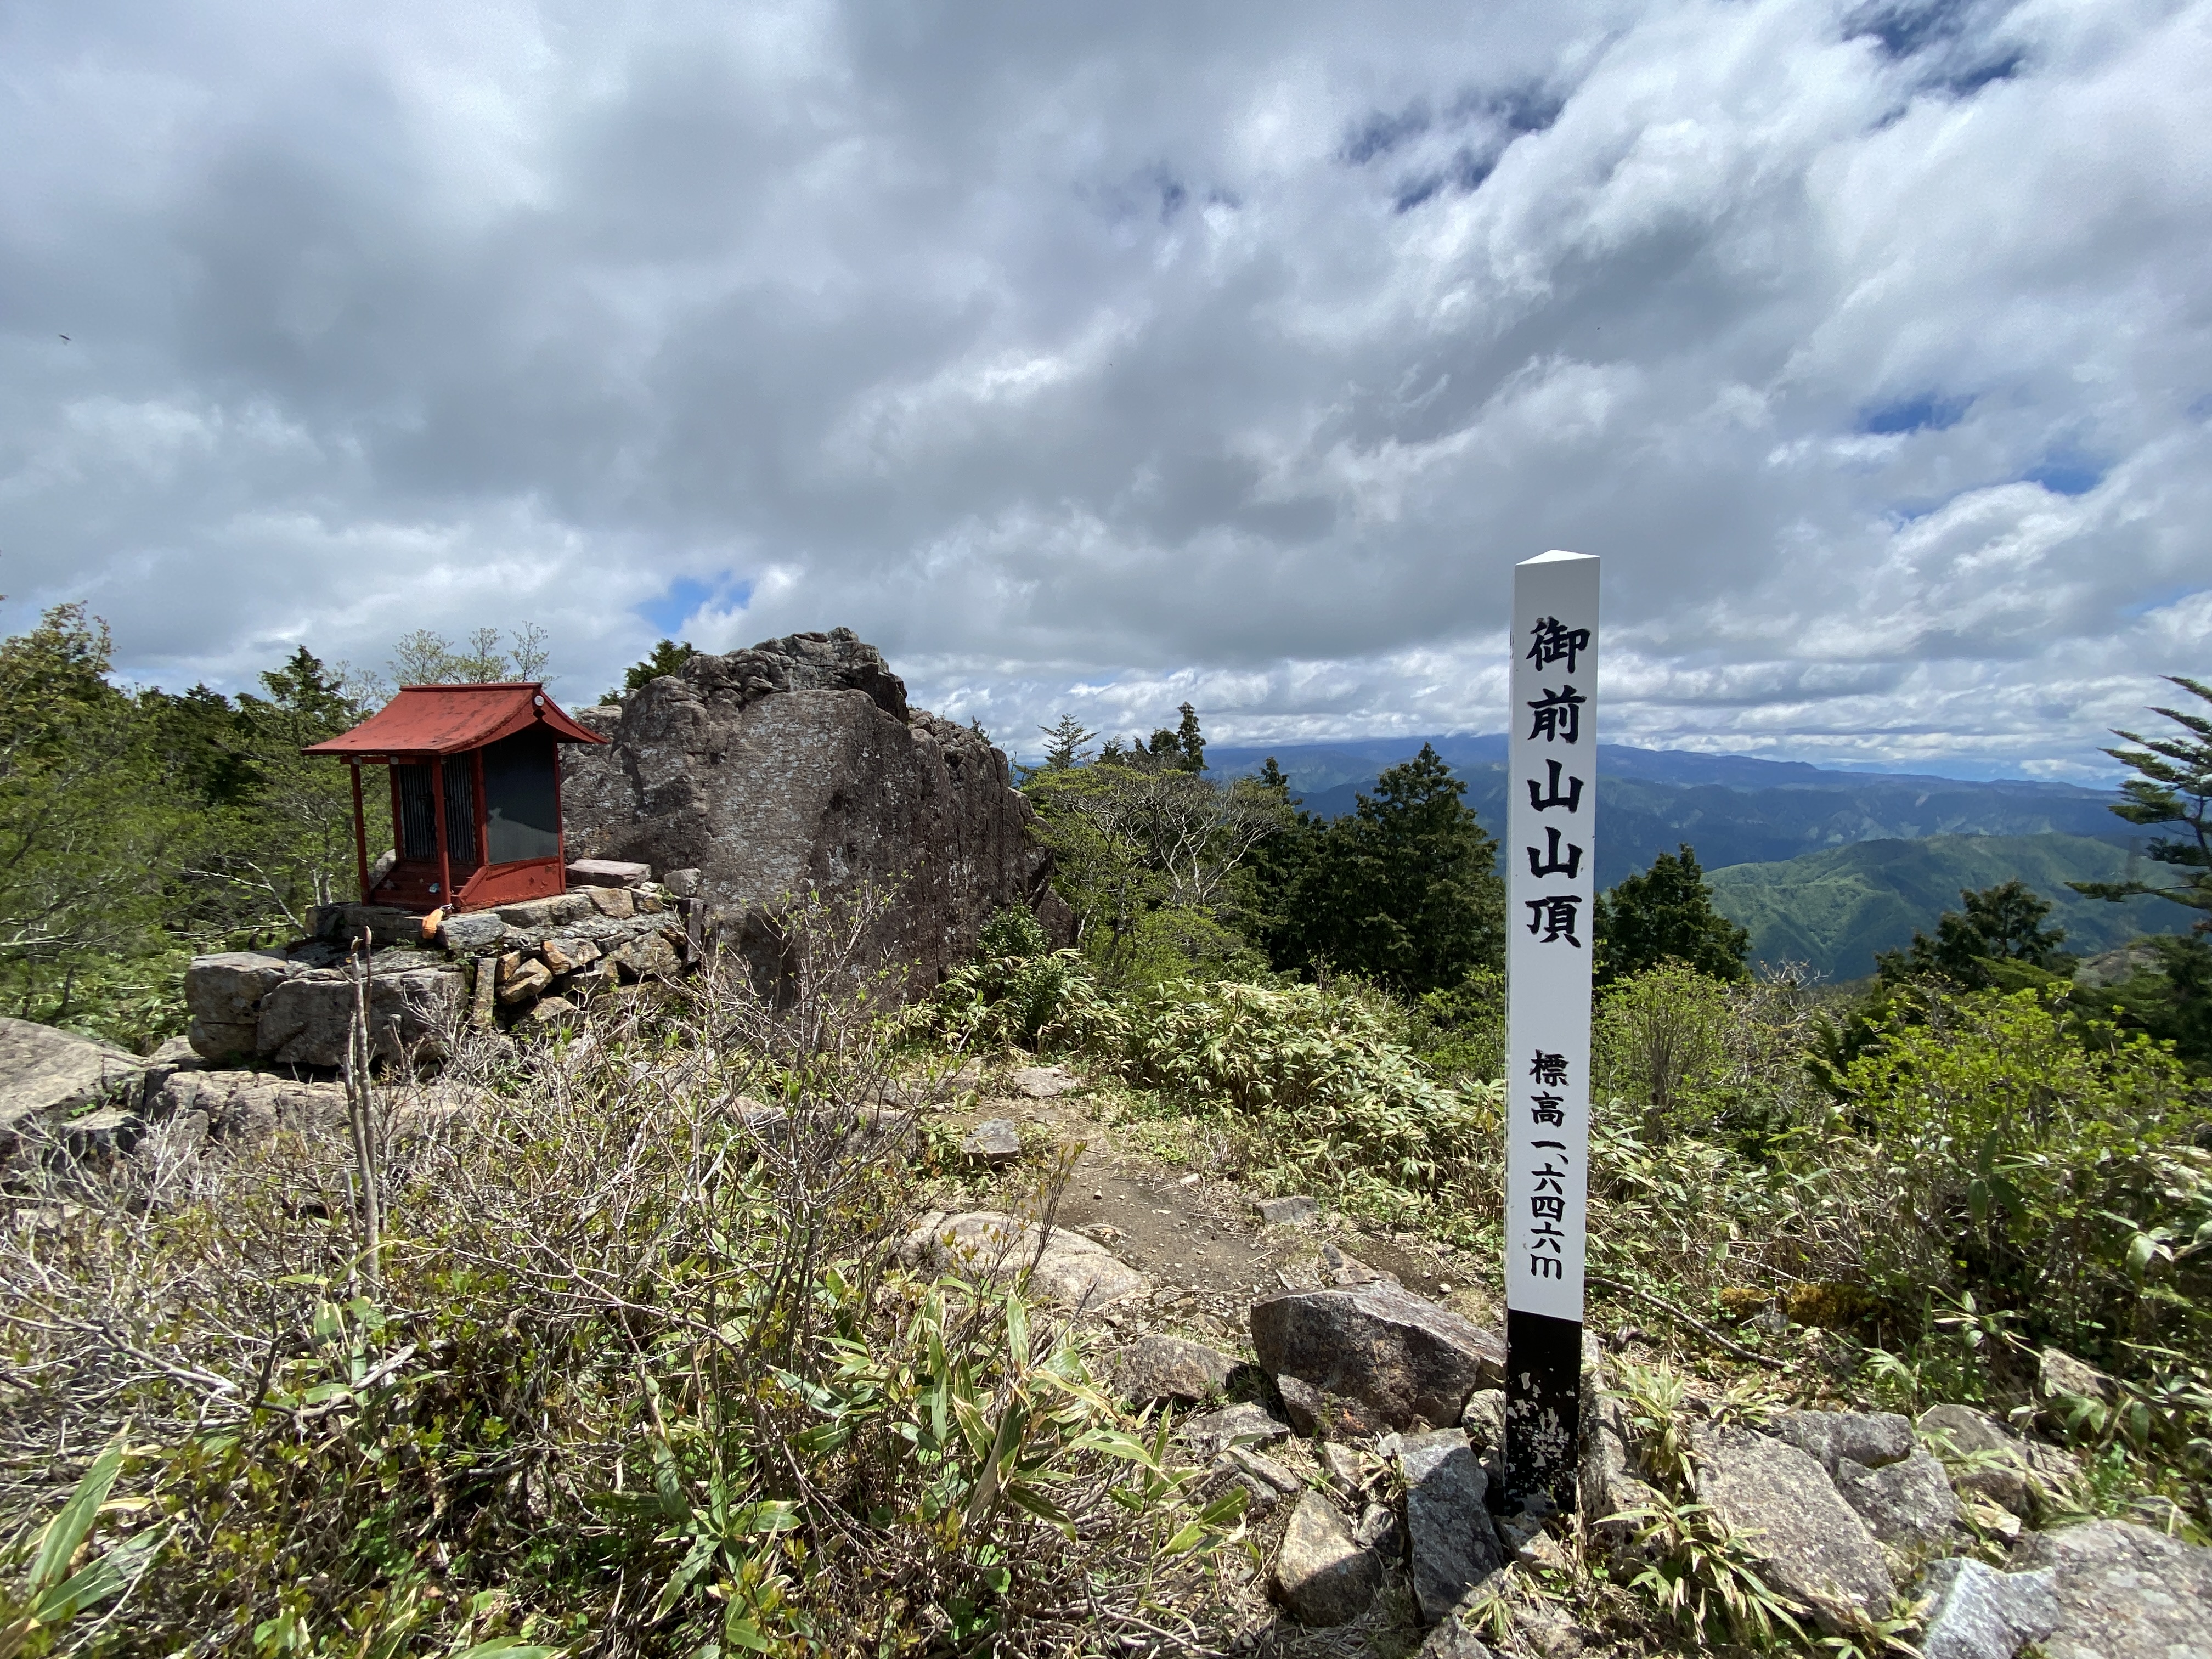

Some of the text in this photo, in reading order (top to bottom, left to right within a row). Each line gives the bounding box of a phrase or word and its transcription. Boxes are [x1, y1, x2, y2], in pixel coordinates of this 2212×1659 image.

[1526, 617, 1590, 948] 御前山山頂
